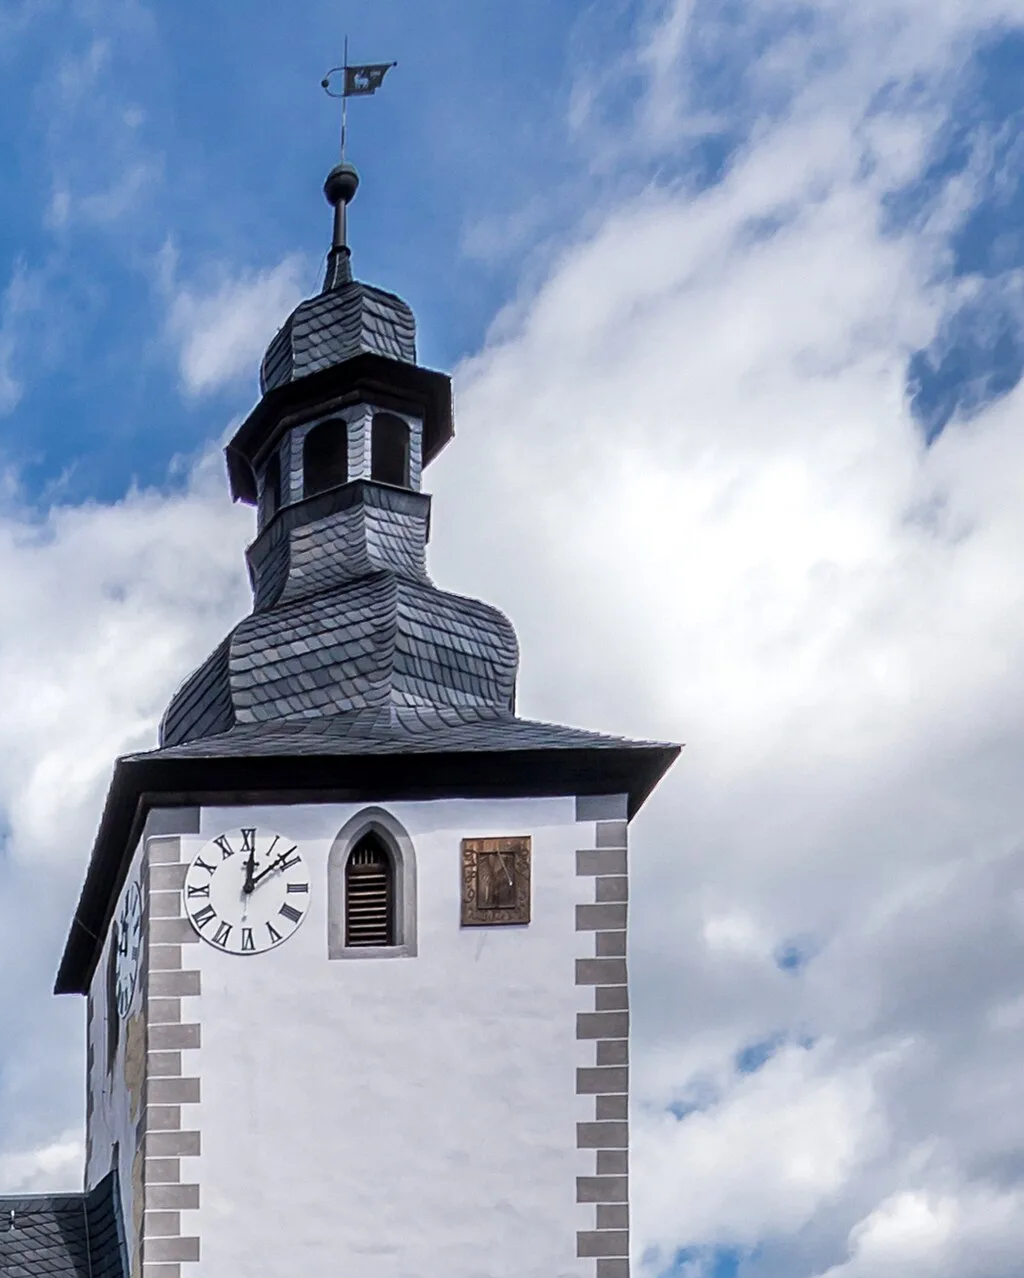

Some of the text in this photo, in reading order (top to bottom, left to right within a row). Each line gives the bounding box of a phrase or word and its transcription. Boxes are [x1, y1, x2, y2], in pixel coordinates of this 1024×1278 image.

[213, 834, 234, 860] XI
[193, 856, 217, 876] X
[188, 883, 210, 898] IX
[241, 928, 256, 950] VI
[266, 921, 282, 944] V
